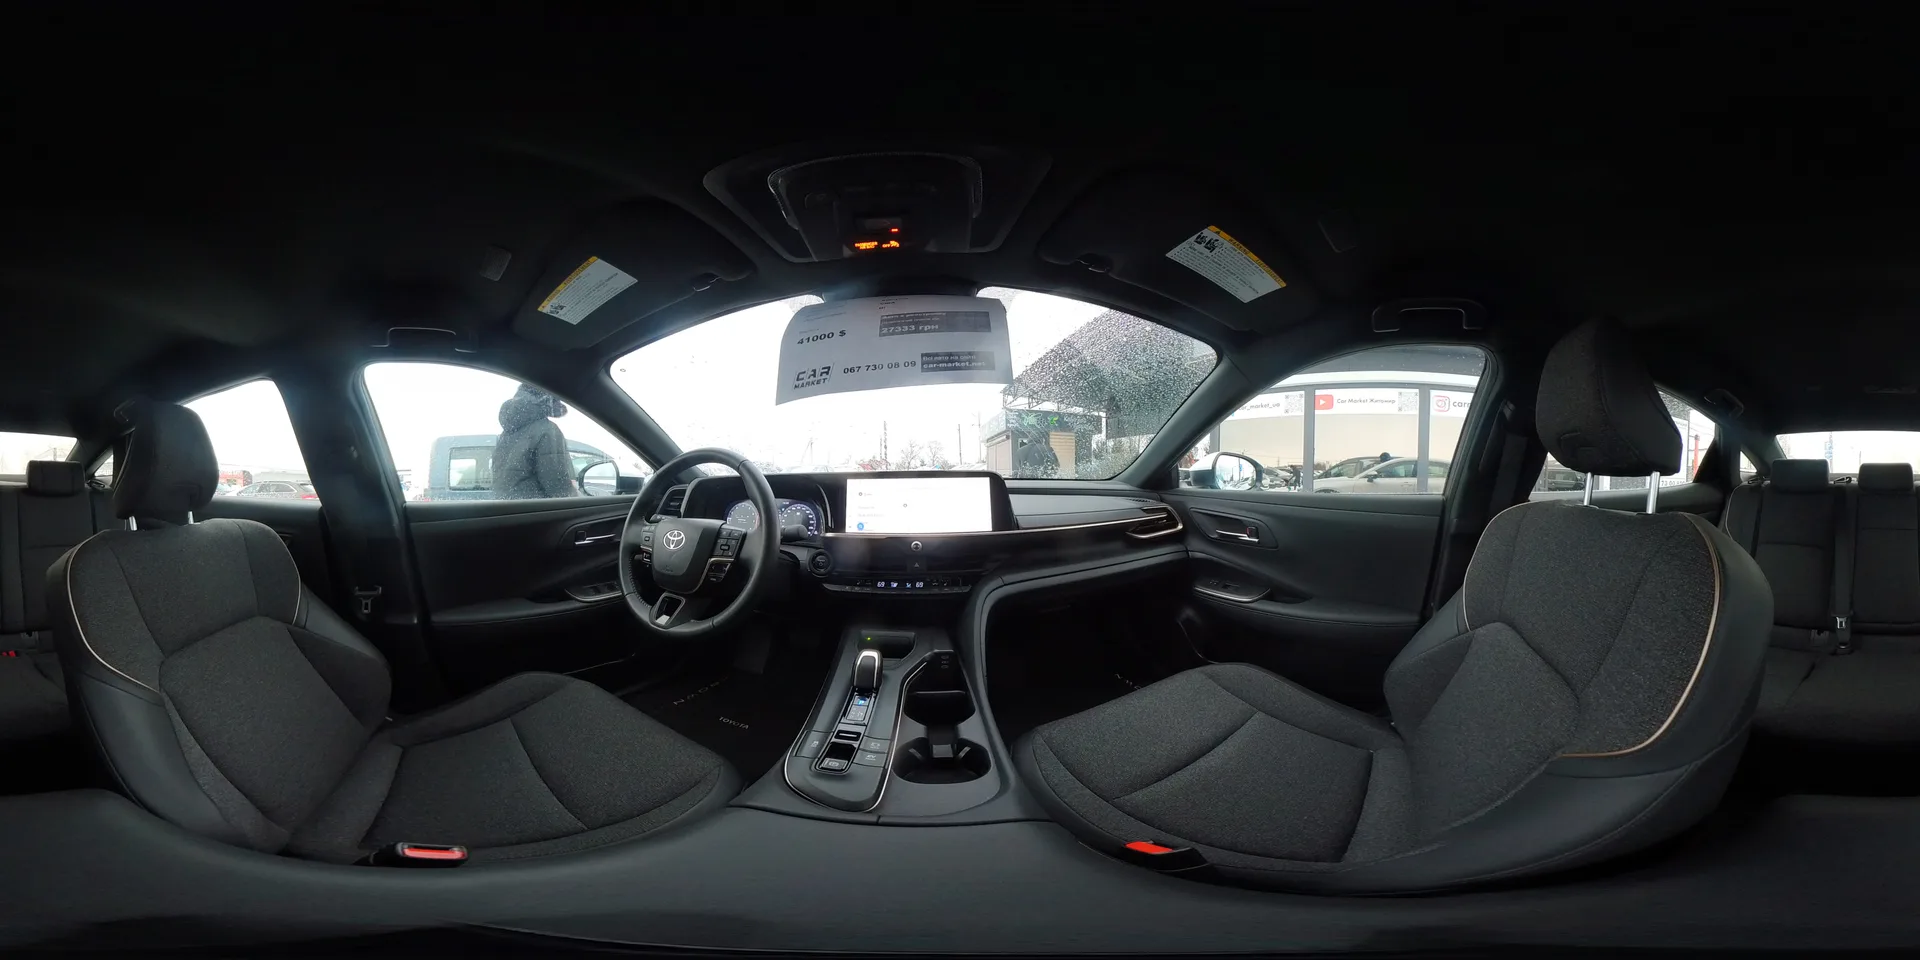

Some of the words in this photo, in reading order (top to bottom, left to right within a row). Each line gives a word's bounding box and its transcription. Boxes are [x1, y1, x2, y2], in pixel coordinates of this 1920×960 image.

[881, 325, 916, 333] 27333
[797, 332, 835, 345] 41000
[838, 329, 847, 337] $
[795, 365, 832, 382] CAR
[843, 366, 862, 374] 067
[865, 363, 884, 372] 730
[887, 361, 900, 369] 08
[903, 360, 917, 368] 09
[793, 377, 829, 390] MARKET
